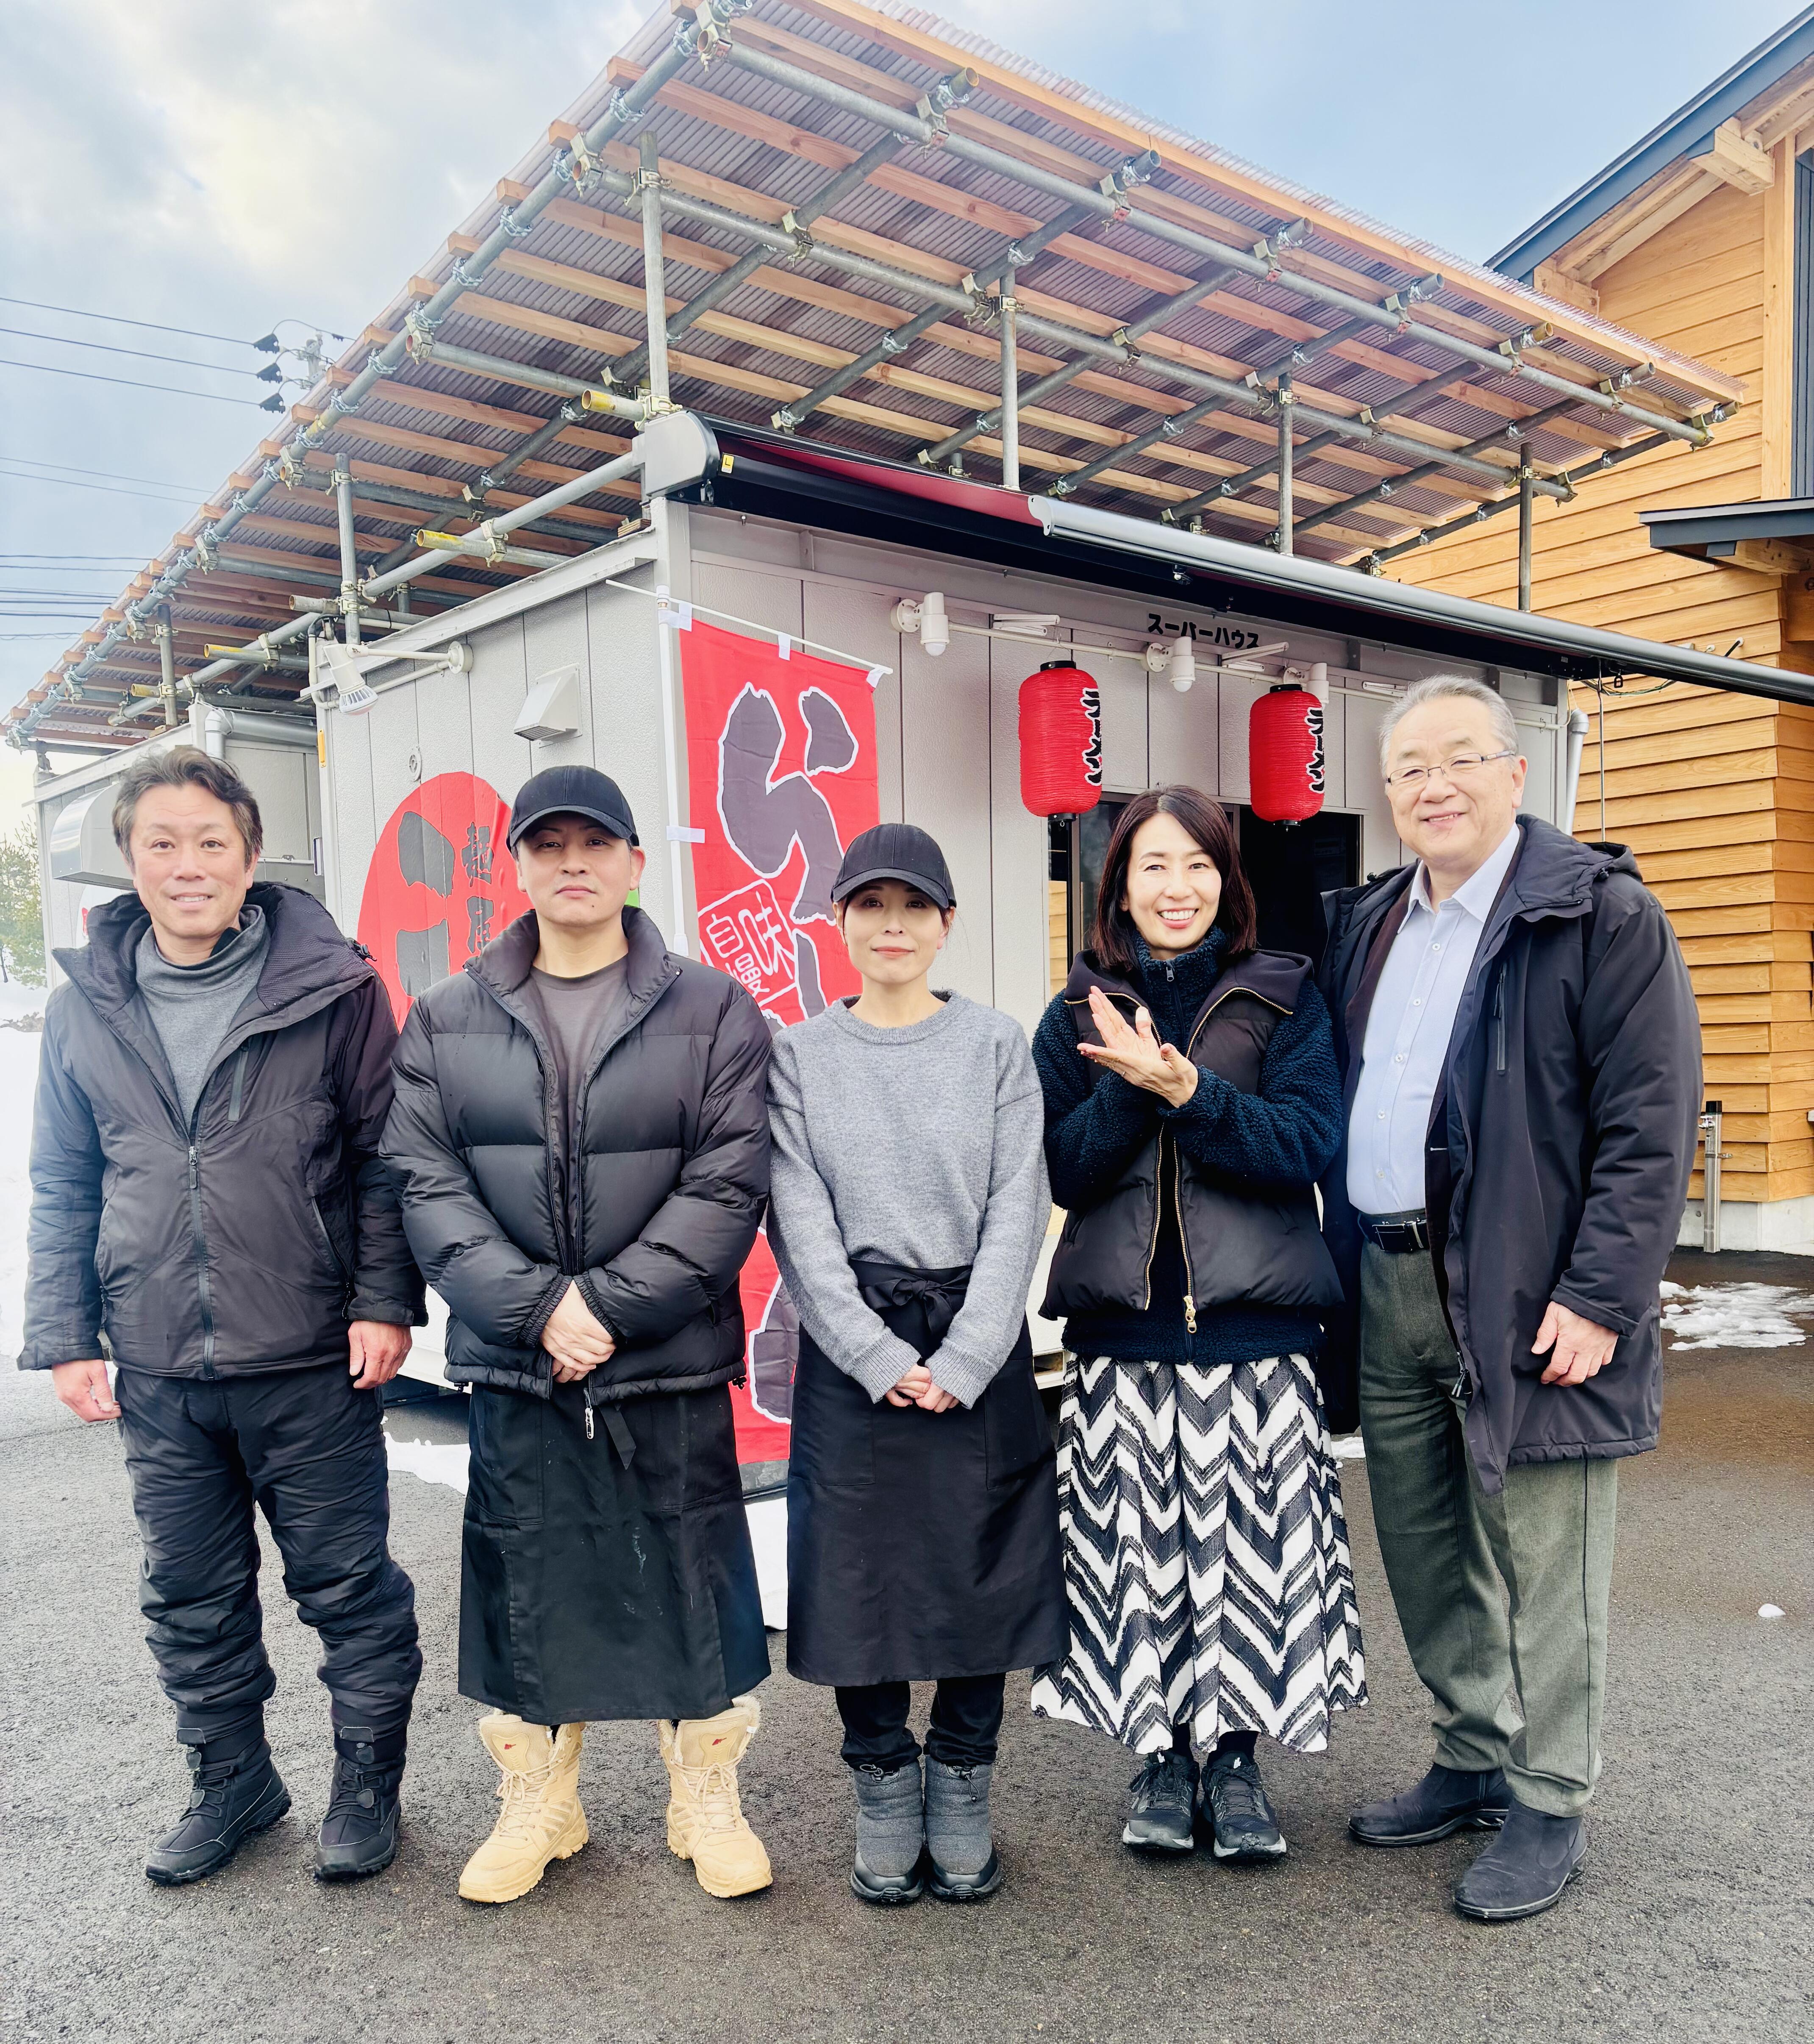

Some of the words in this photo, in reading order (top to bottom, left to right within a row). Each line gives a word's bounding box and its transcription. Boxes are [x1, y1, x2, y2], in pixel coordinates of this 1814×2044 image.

[1147, 613, 1259, 649] スーパーハウス
